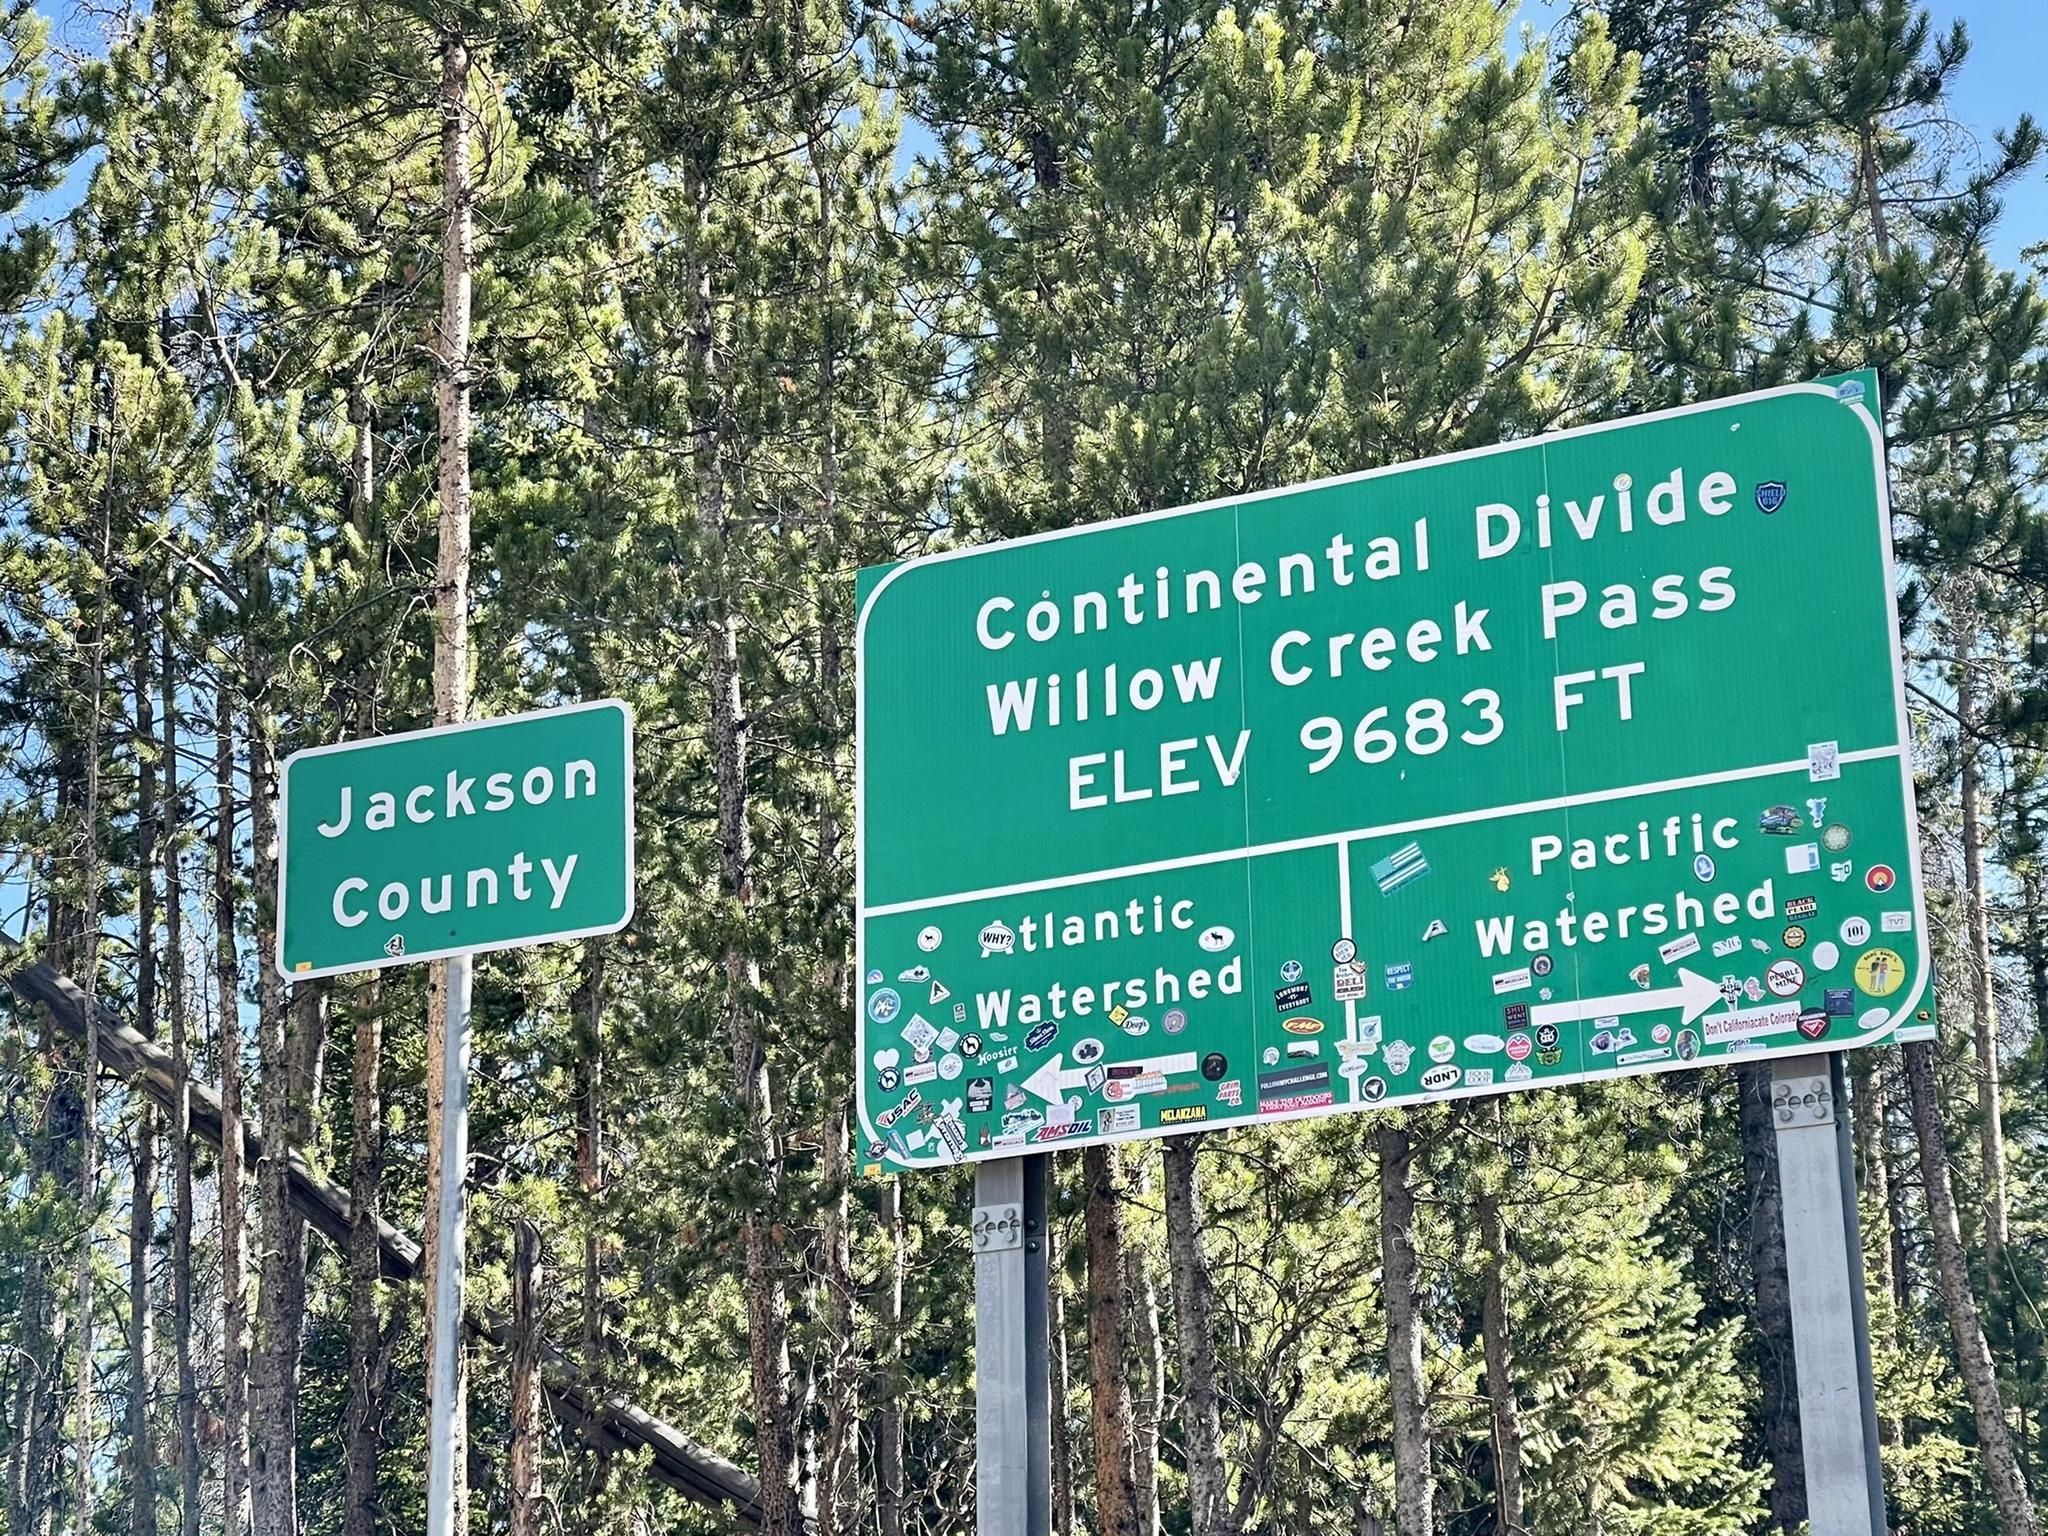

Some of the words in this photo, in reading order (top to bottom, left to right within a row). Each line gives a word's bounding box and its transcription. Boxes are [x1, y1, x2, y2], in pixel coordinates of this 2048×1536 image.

[977, 518, 1428, 649] Continental
[1476, 467, 1736, 559] Divide
[987, 658, 1221, 735] Willow
[1271, 601, 1491, 685] Creek
[1542, 567, 1735, 638] Pass
[1070, 730, 1250, 809] ELEV
[1301, 689, 1503, 773] 9683
[1554, 662, 1644, 730] FT
[318, 759, 596, 838] Jackson
[1532, 813, 1739, 875] Pacific
[333, 852, 578, 927] County
[1476, 879, 1774, 957] Watershed
[983, 932, 1012, 946] WHY?
[1847, 925, 1864, 938] 101
[1769, 968, 1800, 982] PEBBLE
[1775, 977, 1797, 988] MINE
[976, 956, 1242, 1029] Watershed
[1275, 985, 1308, 1000] LONGMONT
[1278, 997, 1310, 1012] EVERYBODY
[1705, 1022, 1722, 1036] Don't
[977, 1045, 1018, 1066] Hoosier
[1220, 1081, 1239, 1091] GRIM
[1424, 1069, 1458, 1086] LNDR
[1218, 1089, 1239, 1099] PARTS
[886, 1089, 918, 1125] USAC
[1160, 1106, 1206, 1122] MELANZANA
[1034, 1121, 1091, 1140] AMSOIL
